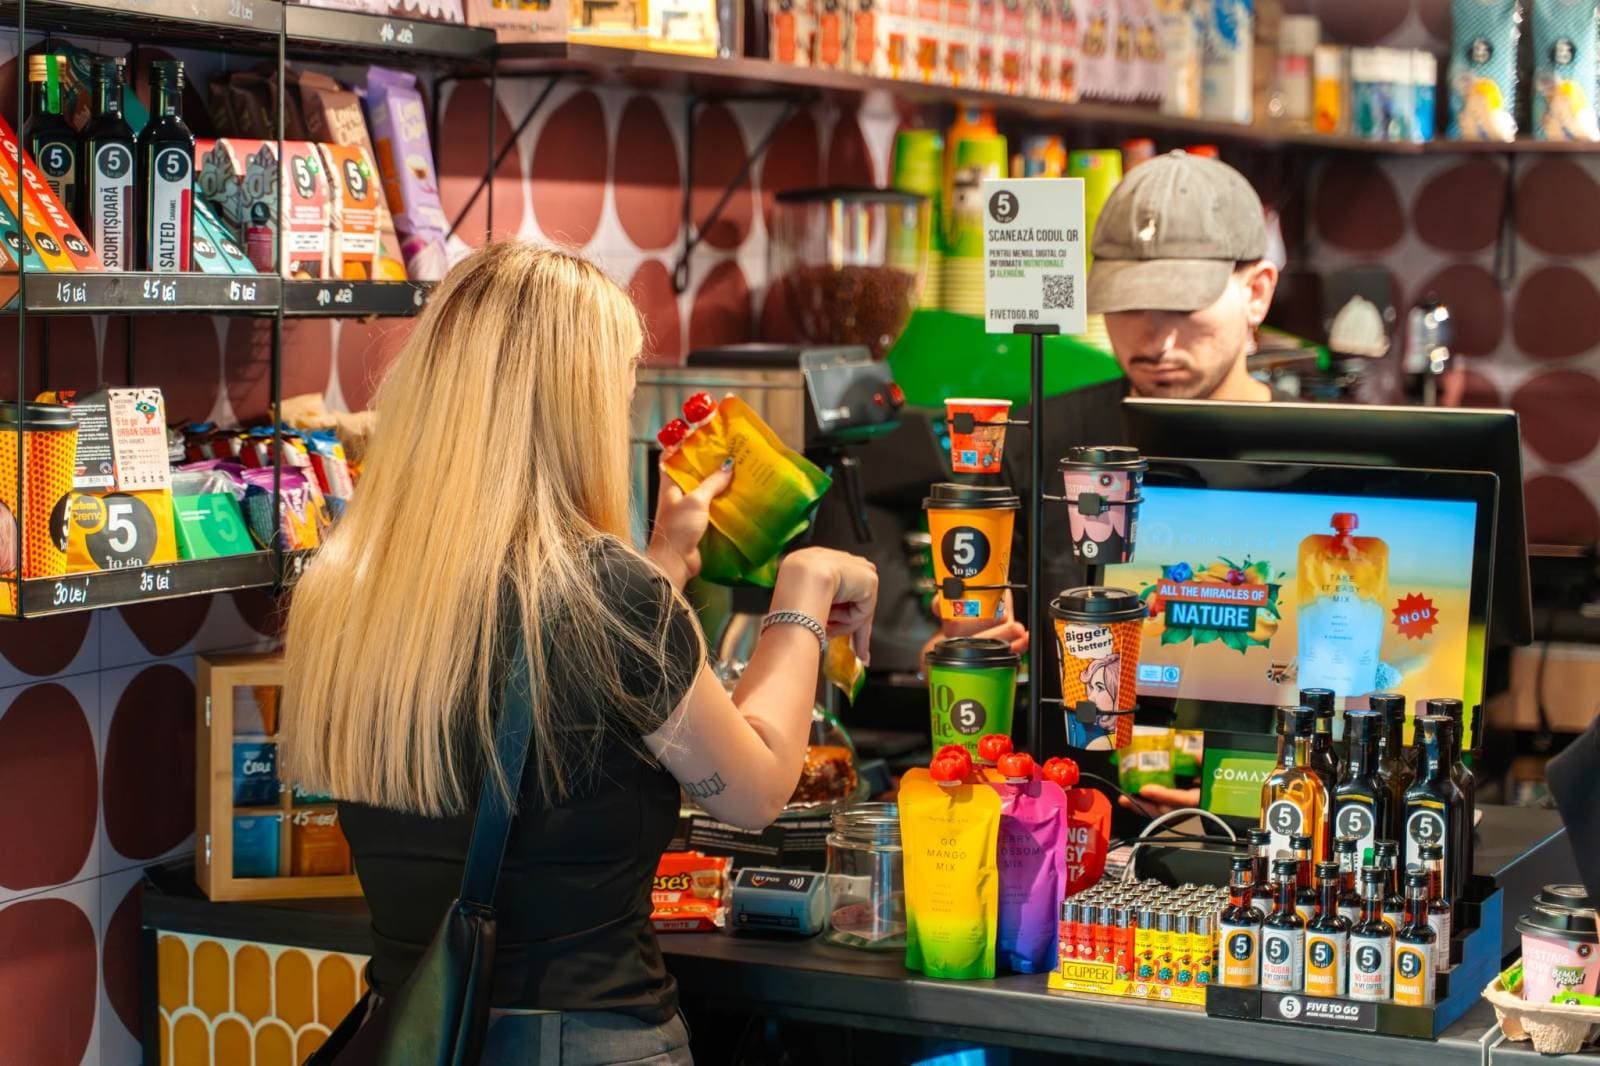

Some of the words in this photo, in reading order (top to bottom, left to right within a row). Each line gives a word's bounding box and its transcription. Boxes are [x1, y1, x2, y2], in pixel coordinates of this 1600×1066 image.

[50, 149, 62, 168] 5
[108, 151, 120, 170] 5
[167, 154, 180, 174] 5
[23, 170, 42, 190] TO
[295, 158, 310, 188] 5
[346, 161, 362, 191] 5
[37, 192, 69, 230] FIVE
[998, 194, 1010, 215] 5
[989, 228, 1034, 242] SCANEAZĂ
[1036, 229, 1064, 242] CODUL
[1066, 229, 1079, 242] QR
[39, 239, 54, 250] 5
[67, 240, 83, 252] 5
[160, 222, 175, 267] SALTED
[56, 282, 70, 302] 15
[143, 280, 160, 300] 25
[990, 309, 1040, 320] FIVETOGO.RO
[108, 504, 138, 552] 5
[210, 496, 238, 542] 5
[954, 533, 975, 564] 5
[1086, 544, 1093, 553] 5
[106, 556, 122, 570] to
[952, 565, 964, 576] to
[965, 567, 978, 577] go
[140, 572, 154, 591] 35
[1330, 574, 1355, 582] TAKE
[53, 582, 68, 606] 30
[1160, 585, 1178, 596] ALL
[1180, 586, 1198, 597] THE
[1200, 588, 1248, 600] MIRACLES
[1252, 590, 1264, 601] OF
[1172, 603, 1249, 627] NATURE
[1400, 608, 1430, 624] NOU
[1066, 628, 1107, 642] Bigger
[960, 703, 976, 726] 5
[1278, 808, 1292, 826] 5
[1349, 812, 1362, 832] 5
[1066, 828, 1088, 844] NG
[1419, 818, 1432, 838] 5
[940, 838, 956, 846] GO
[927, 850, 966, 860] MANGO
[1066, 847, 1088, 862] GY
[936, 863, 956, 872] MIX
[1236, 937, 1247, 954] 5
[1270, 940, 1281, 958] 5
[1315, 944, 1326, 962] 5
[1362, 950, 1374, 966] 5
[1402, 954, 1414, 972] 5
[1066, 966, 1109, 980] CLIPPER
[1271, 965, 1290, 974] SUGAR
[1363, 974, 1382, 982] SUGAR
[1286, 1000, 1294, 1012] 5
[1306, 1002, 1328, 1012] FIVE
[1330, 1004, 1342, 1013] TO
[1343, 1006, 1359, 1015] GO
